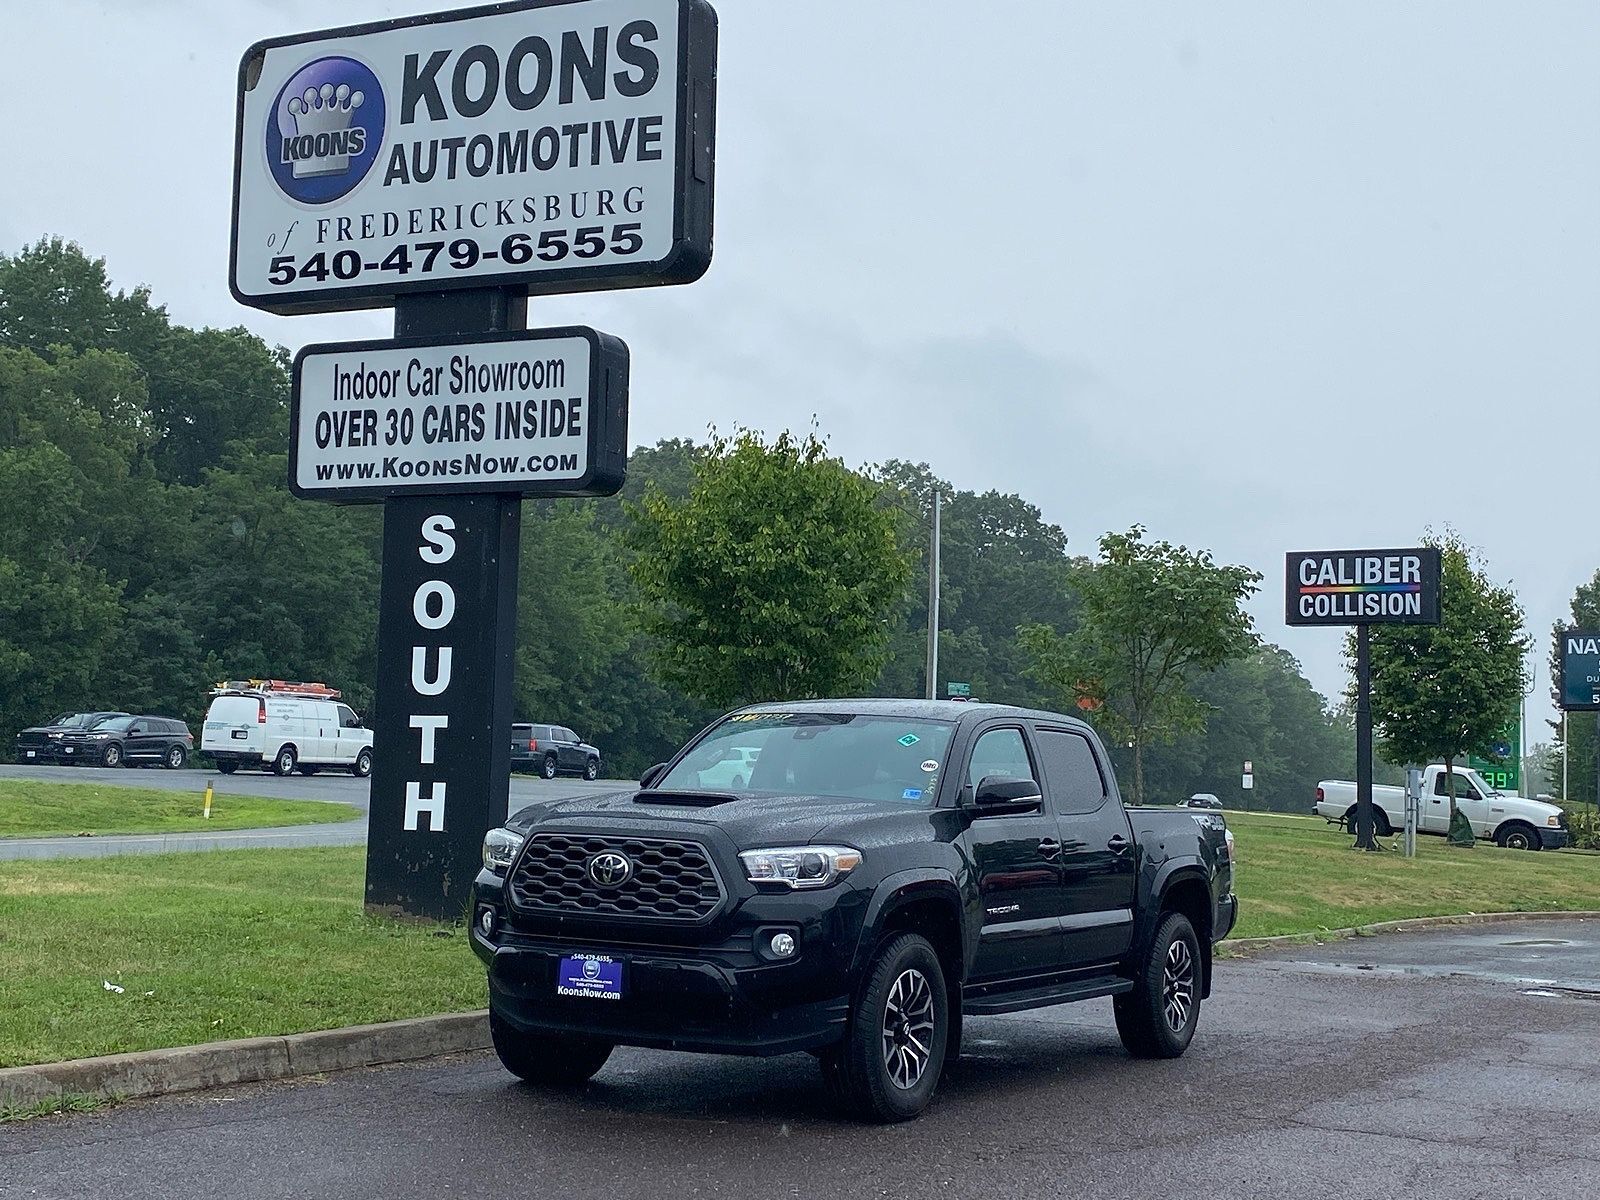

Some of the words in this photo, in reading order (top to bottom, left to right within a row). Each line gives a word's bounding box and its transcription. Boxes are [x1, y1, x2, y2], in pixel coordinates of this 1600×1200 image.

[400, 20, 660, 125] KOONS
[283, 127, 367, 162] KOONS
[383, 115, 663, 187] AUTOMOTIVE
[267, 221, 297, 254] of
[316, 186, 646, 243] FREDERICKSBURG
[268, 223, 644, 285] 540-479-6555
[334, 362, 400, 401] Indoor
[407, 358, 443, 397] Car
[450, 355, 565, 395] Showroom
[315, 409, 377, 449] OVER
[385, 407, 414, 446] 30
[422, 403, 485, 444] CARS
[495, 398, 582, 440] INSIDE
[1299, 556, 1421, 585] CALIBER
[1299, 592, 1421, 617] COLLISION
[1567, 638, 1600, 655] NA
[403, 515, 456, 832] SOUTH
[557, 985, 621, 1000] KoonsNow.com
